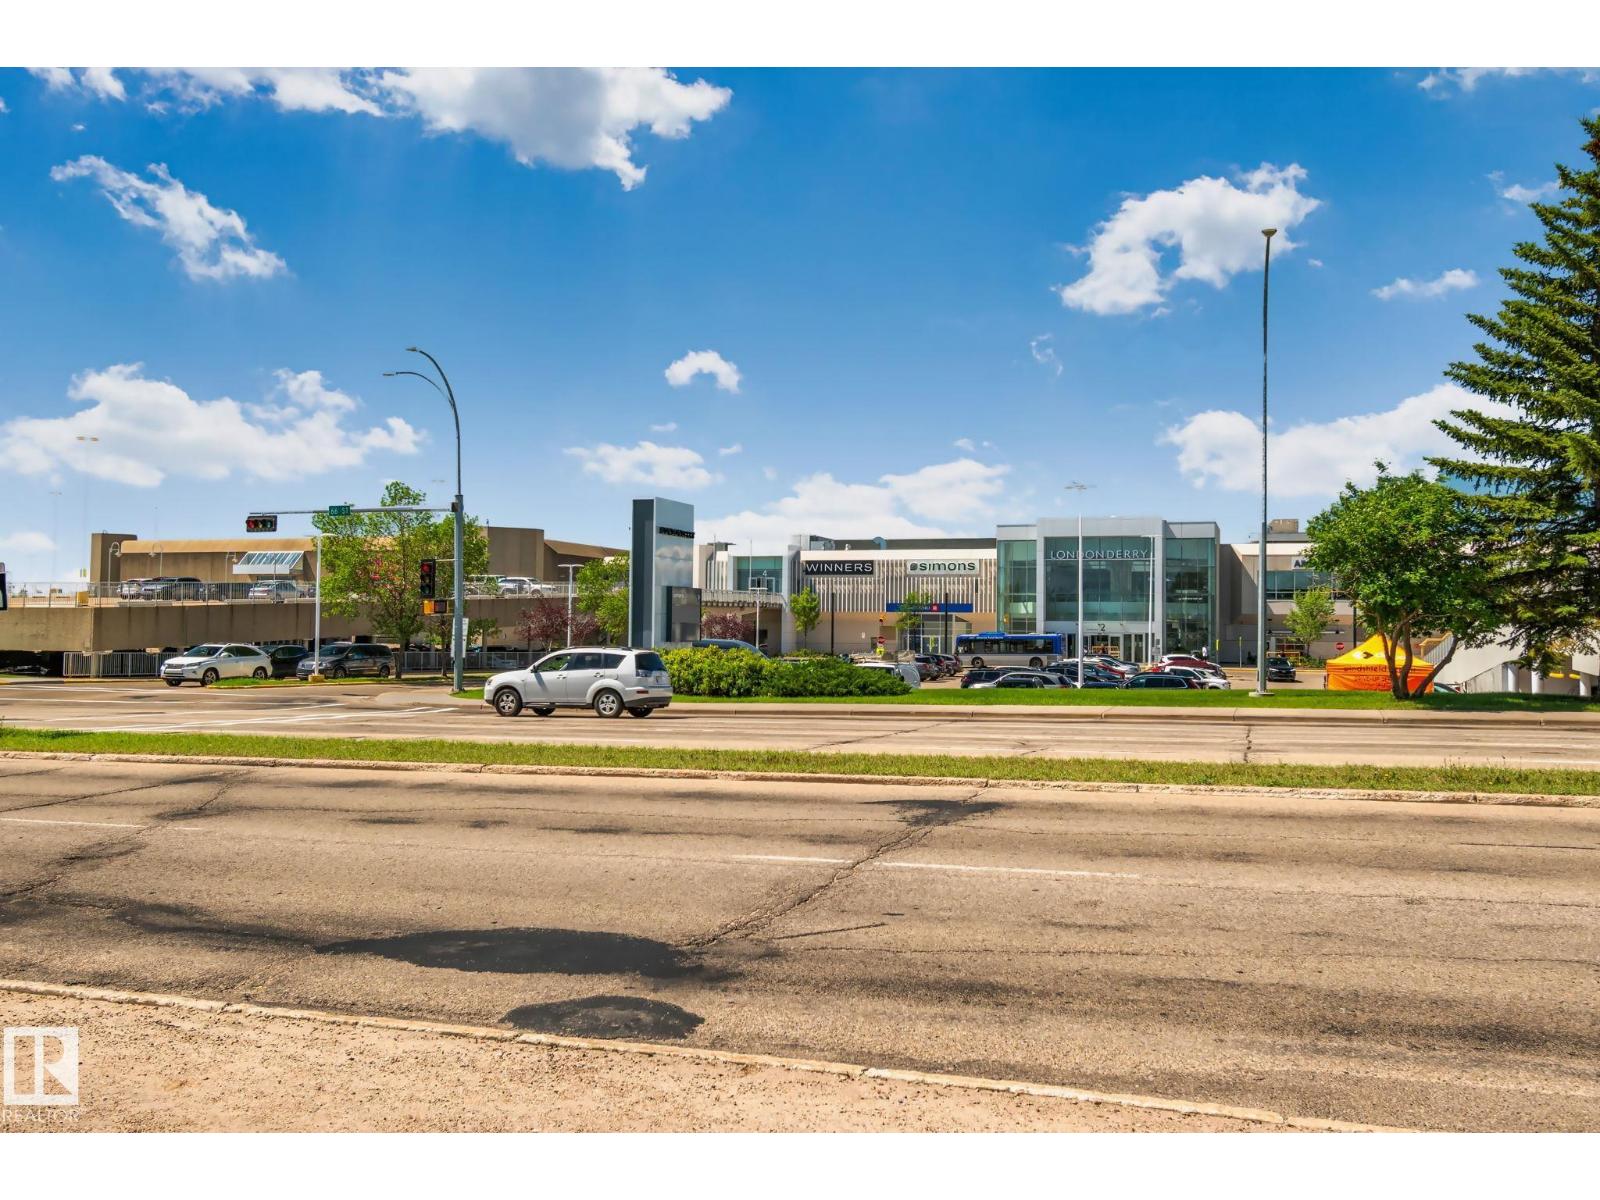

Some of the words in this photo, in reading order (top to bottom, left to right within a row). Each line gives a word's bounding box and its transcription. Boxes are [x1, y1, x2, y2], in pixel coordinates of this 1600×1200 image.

[1050, 549, 1148, 560] LONDONDERRY
[806, 563, 873, 572] WINNERS
[919, 561, 976, 571] simons
